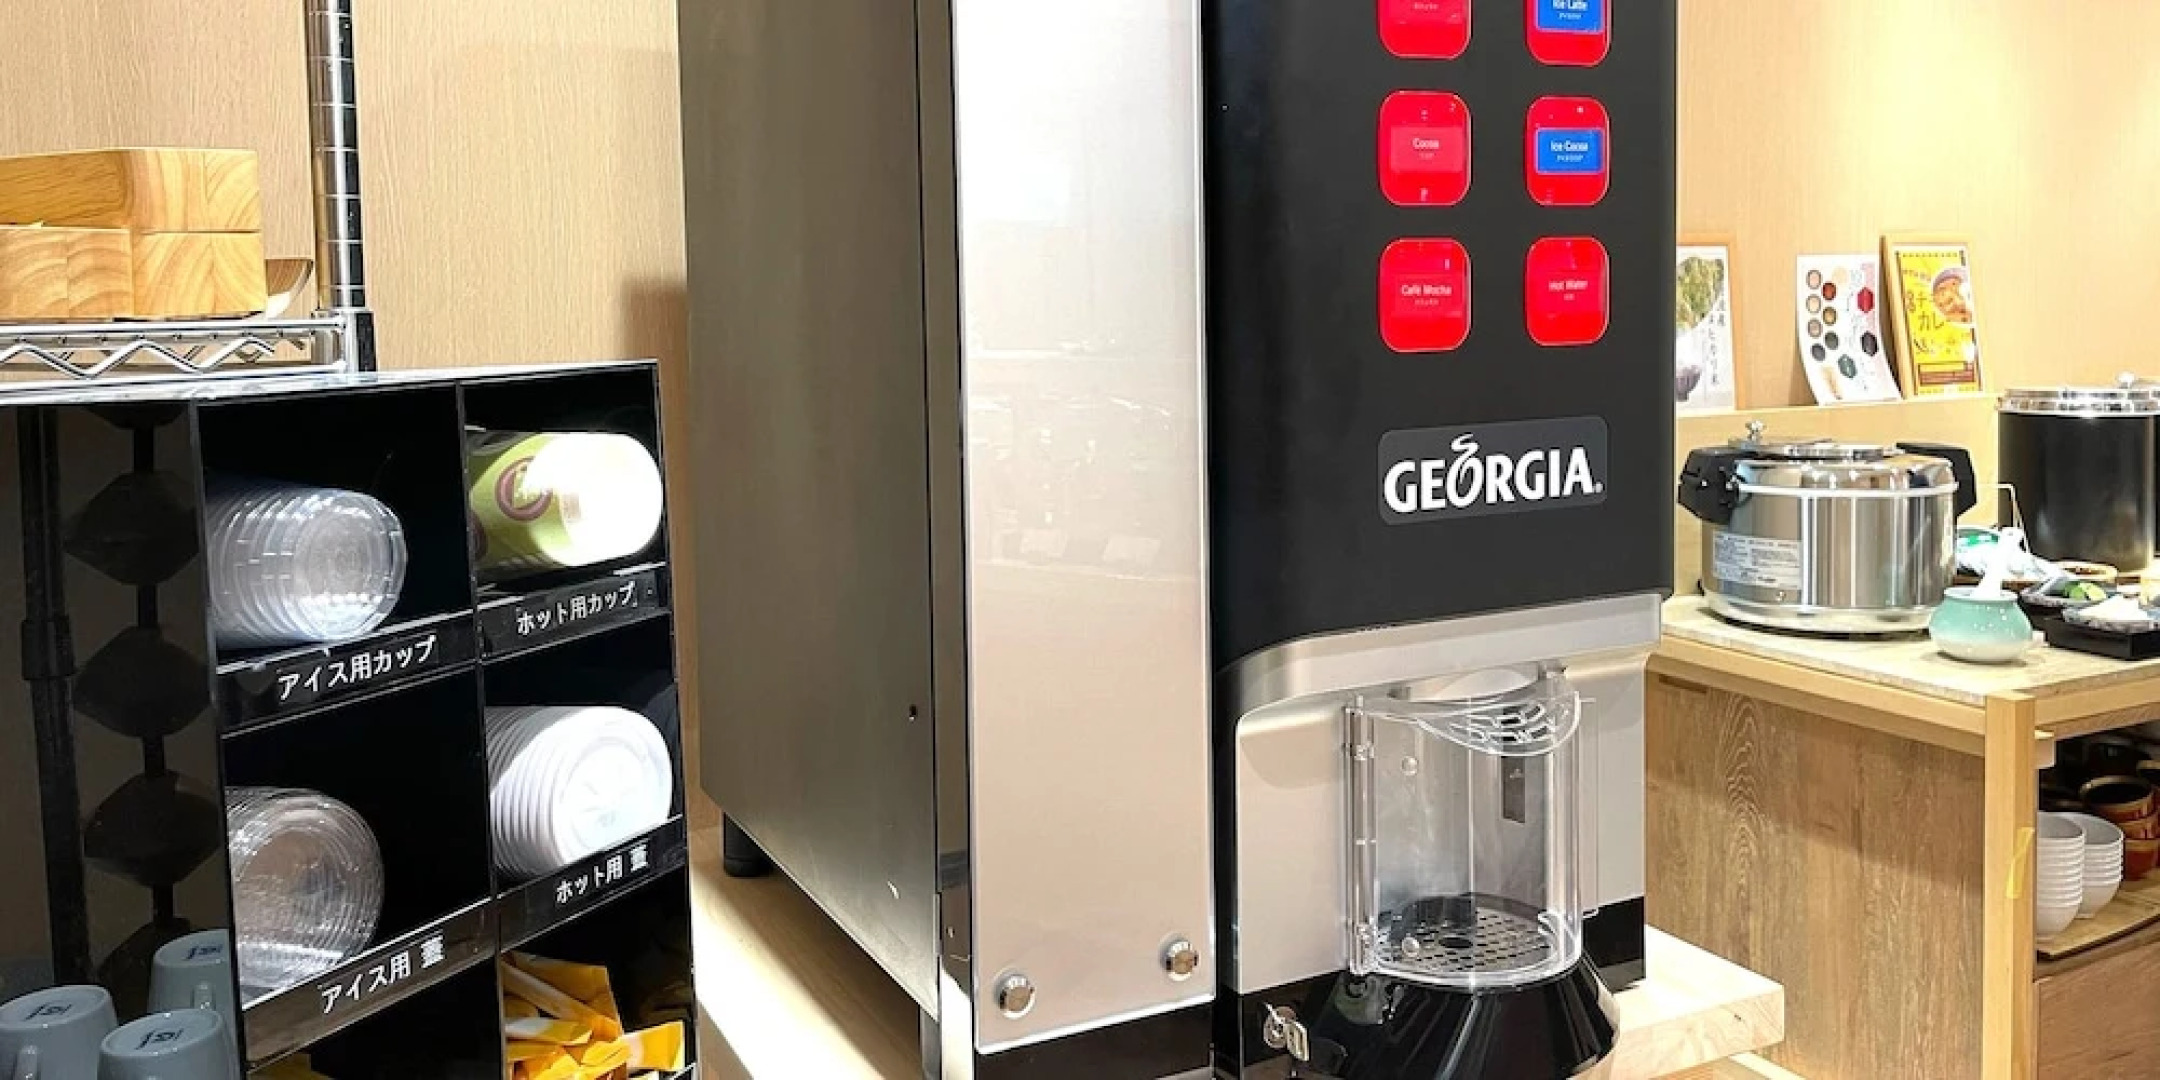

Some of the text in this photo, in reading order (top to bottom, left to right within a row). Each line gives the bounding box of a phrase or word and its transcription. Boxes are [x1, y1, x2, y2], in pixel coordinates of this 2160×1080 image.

[1384, 434, 1595, 513] GEORGIA
[516, 580, 637, 636] ホット用カップ
[278, 634, 437, 701] アイス用カップ
[556, 854, 623, 904] ホット用
[321, 950, 412, 1014] アイス用
